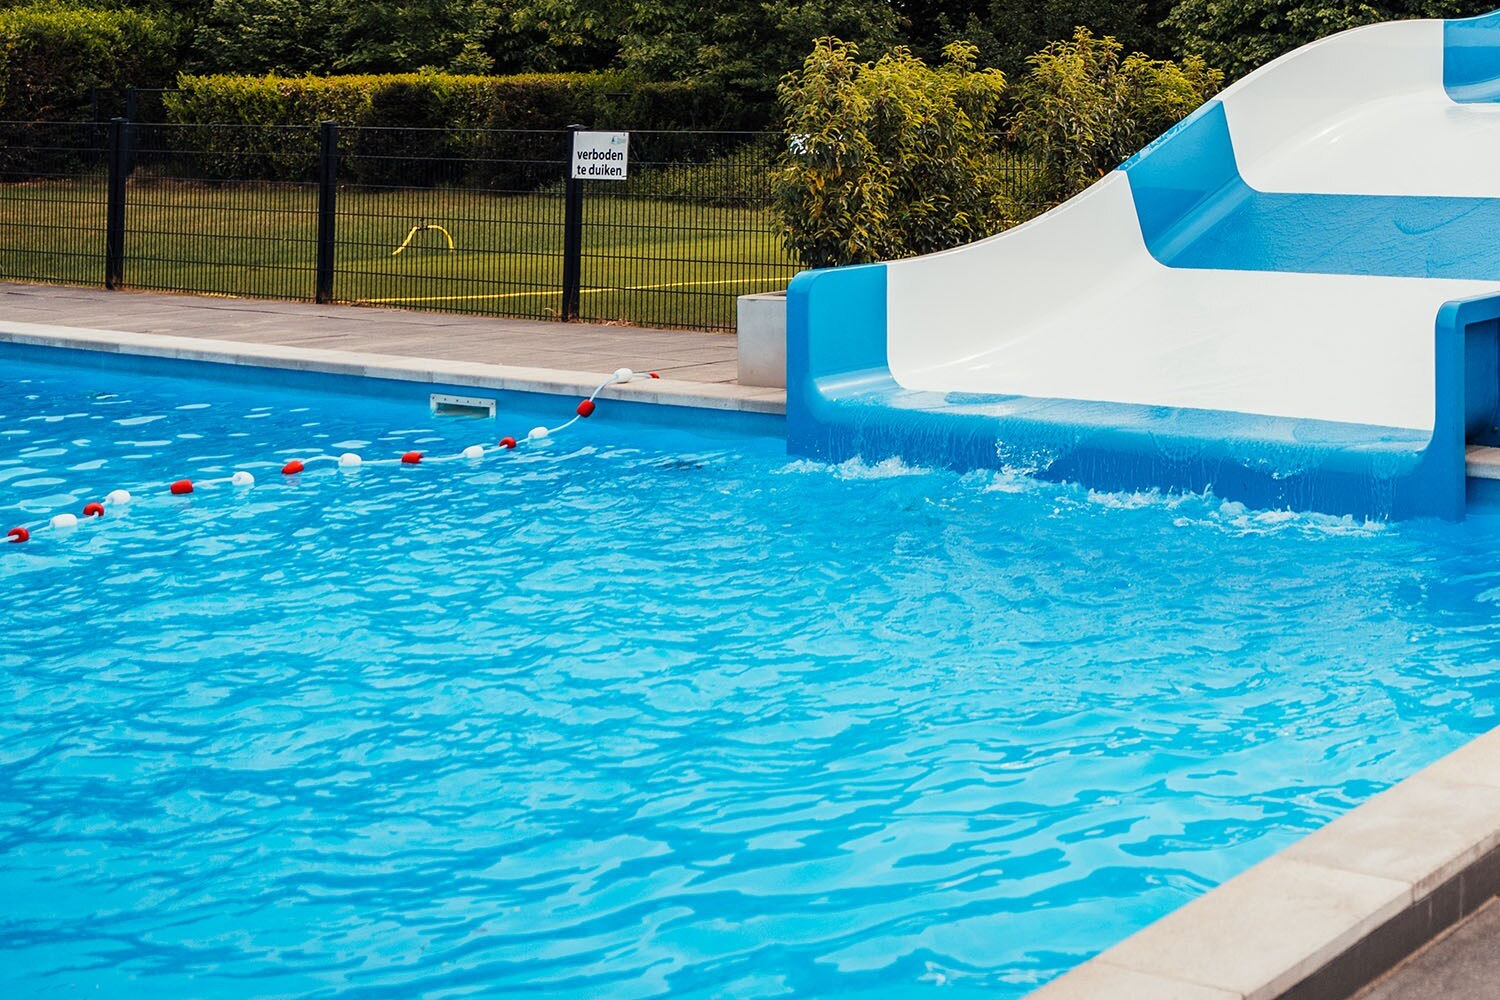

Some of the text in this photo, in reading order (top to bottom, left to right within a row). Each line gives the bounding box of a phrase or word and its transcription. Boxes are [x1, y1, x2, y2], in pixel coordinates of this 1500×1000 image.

[577, 148, 623, 161] verboden
[577, 164, 622, 176] te duiken
